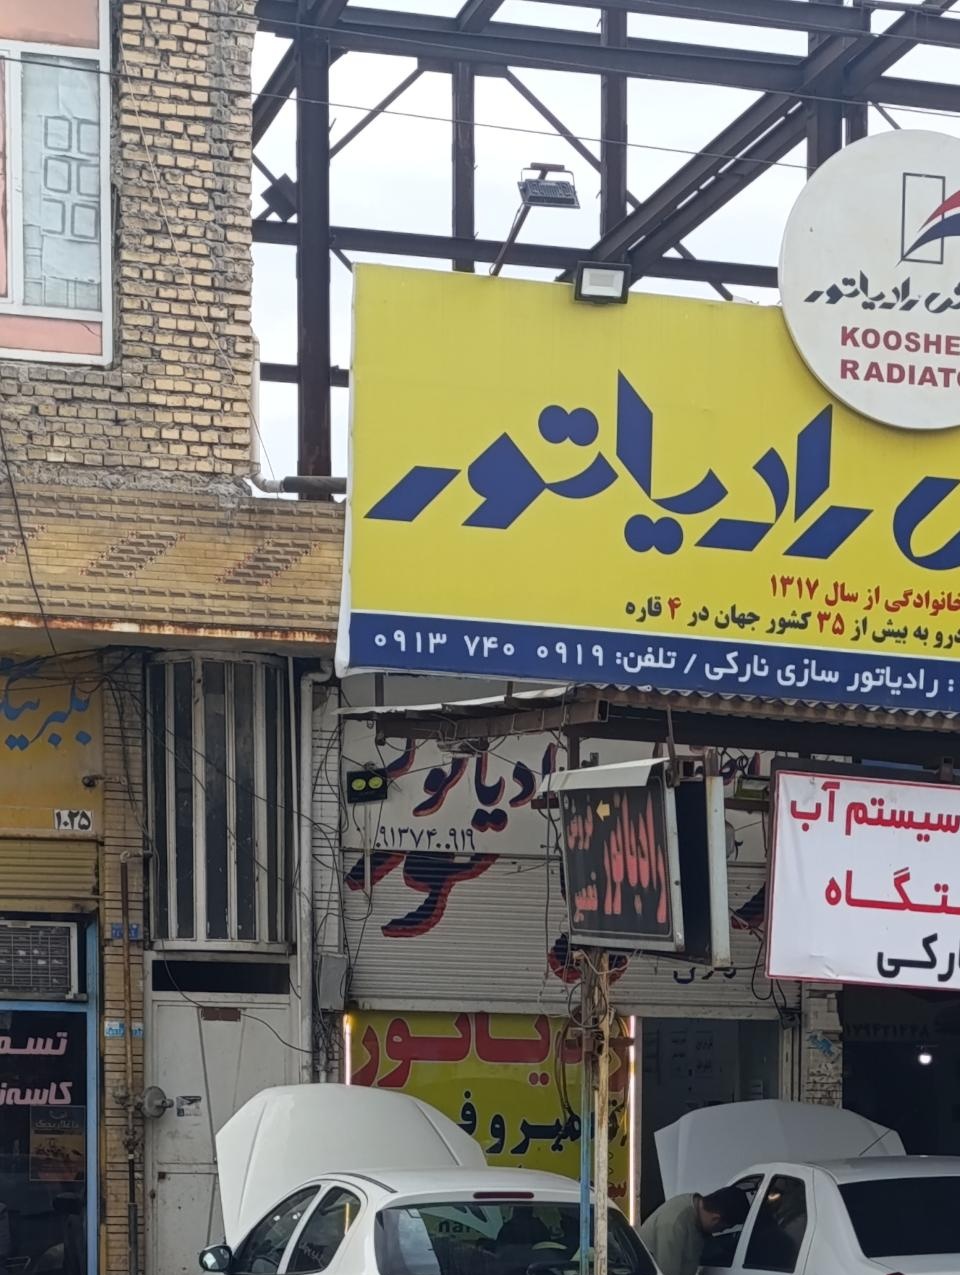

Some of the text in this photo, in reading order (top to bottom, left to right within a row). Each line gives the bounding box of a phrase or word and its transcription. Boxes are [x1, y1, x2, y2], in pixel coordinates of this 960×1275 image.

[804, 270, 919, 311] رادیاتور
[363, 369, 874, 559] رادیاتور
[770, 574, 819, 600] ۱۳۱۷
[825, 581, 858, 606] سال
[863, 585, 880, 610] از
[625, 596, 662, 622] قاره
[667, 597, 682, 620] ۴
[687, 606, 709, 627] در
[715, 604, 760, 631] جهان
[766, 610, 812, 634] کشور
[817, 611, 845, 635] ۳۵
[850, 616, 867, 641] از
[872, 619, 908, 644] بیش
[913, 625, 929, 641] به
[375, 630, 447, 654] ۰۹۱۳
[464, 635, 515, 657] ۷۴۰
[537, 641, 604, 666] ۰۹۱۹
[704, 651, 769, 682] نارکی
[777, 658, 839, 687] سازی
[847, 666, 939, 698] رادیاتور
[791, 782, 840, 832] آب
[846, 797, 960, 842] سیستم
[56, 810, 91, 830] ۱۰۲۵
[0, 1032, 68, 1055] تسم
[439, 1219, 472, 1233] nar
